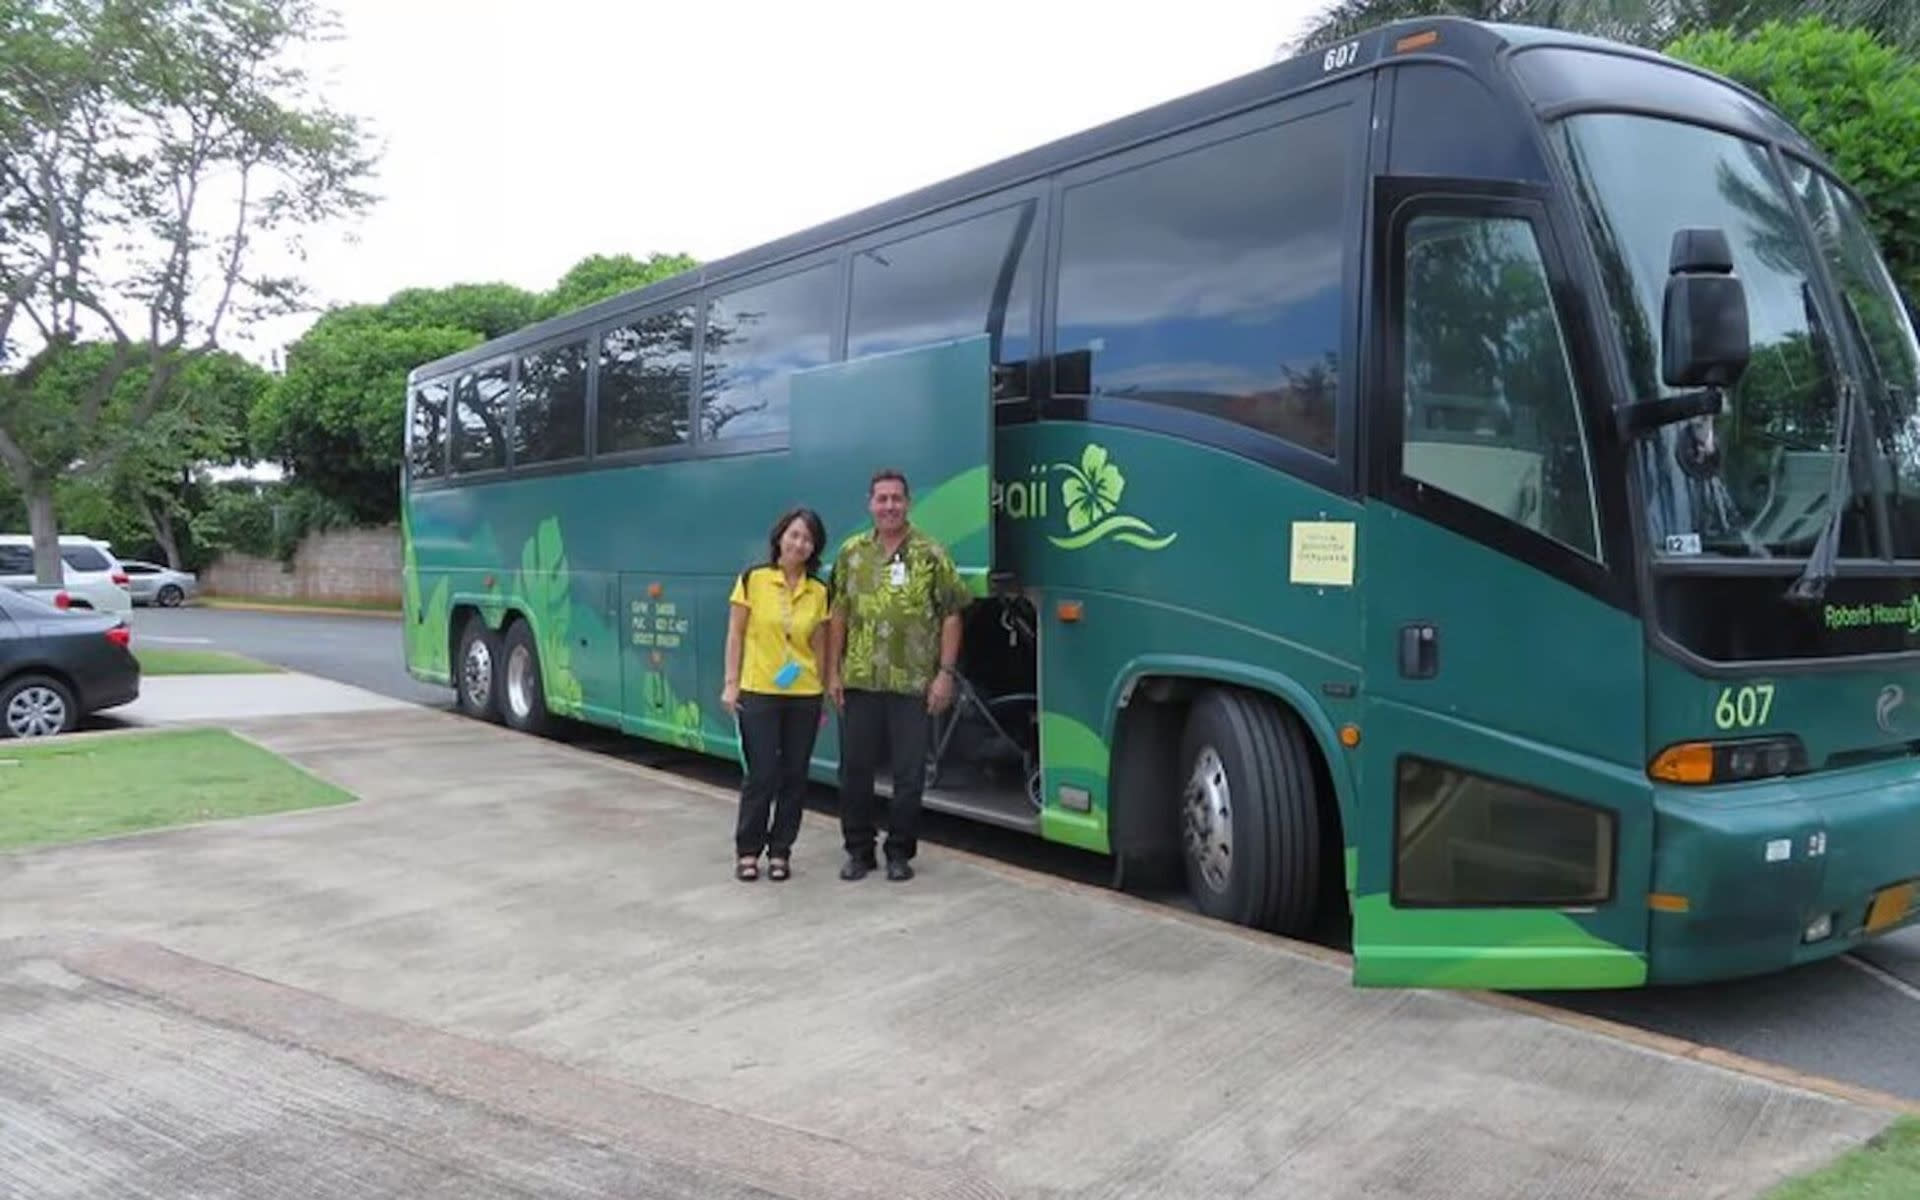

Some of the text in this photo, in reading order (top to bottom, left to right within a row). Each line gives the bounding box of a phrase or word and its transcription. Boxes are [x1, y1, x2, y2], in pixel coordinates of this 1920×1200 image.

[1323, 41, 1360, 71] 607
[1824, 604, 1871, 630] Roberts
[1715, 684, 1775, 730] 607
